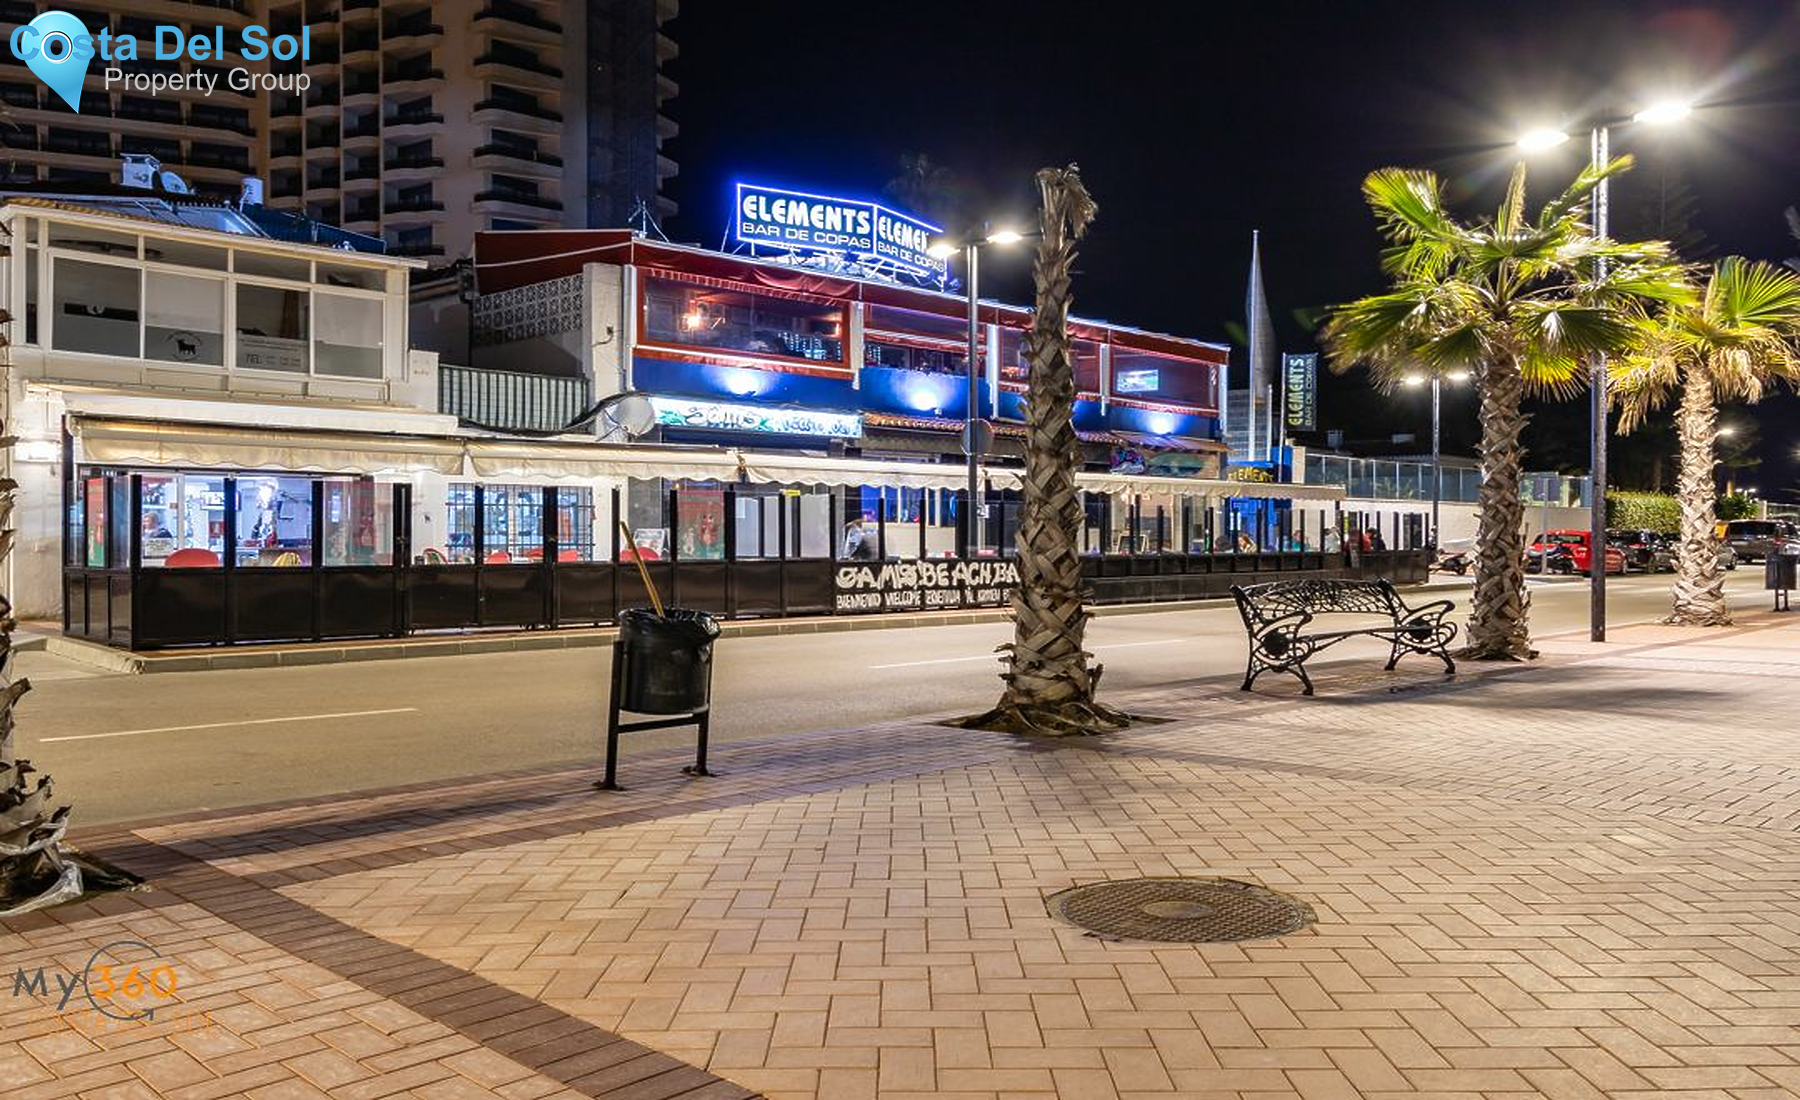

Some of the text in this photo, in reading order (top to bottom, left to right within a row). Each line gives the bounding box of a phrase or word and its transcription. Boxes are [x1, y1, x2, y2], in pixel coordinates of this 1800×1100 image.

[742, 195, 871, 235] ELEMENTS
[742, 223, 871, 250] BAR DE COPAS
[878, 241, 899, 257] BAR
[900, 248, 913, 262] DE
[1287, 358, 1305, 426] ELEMENTS
